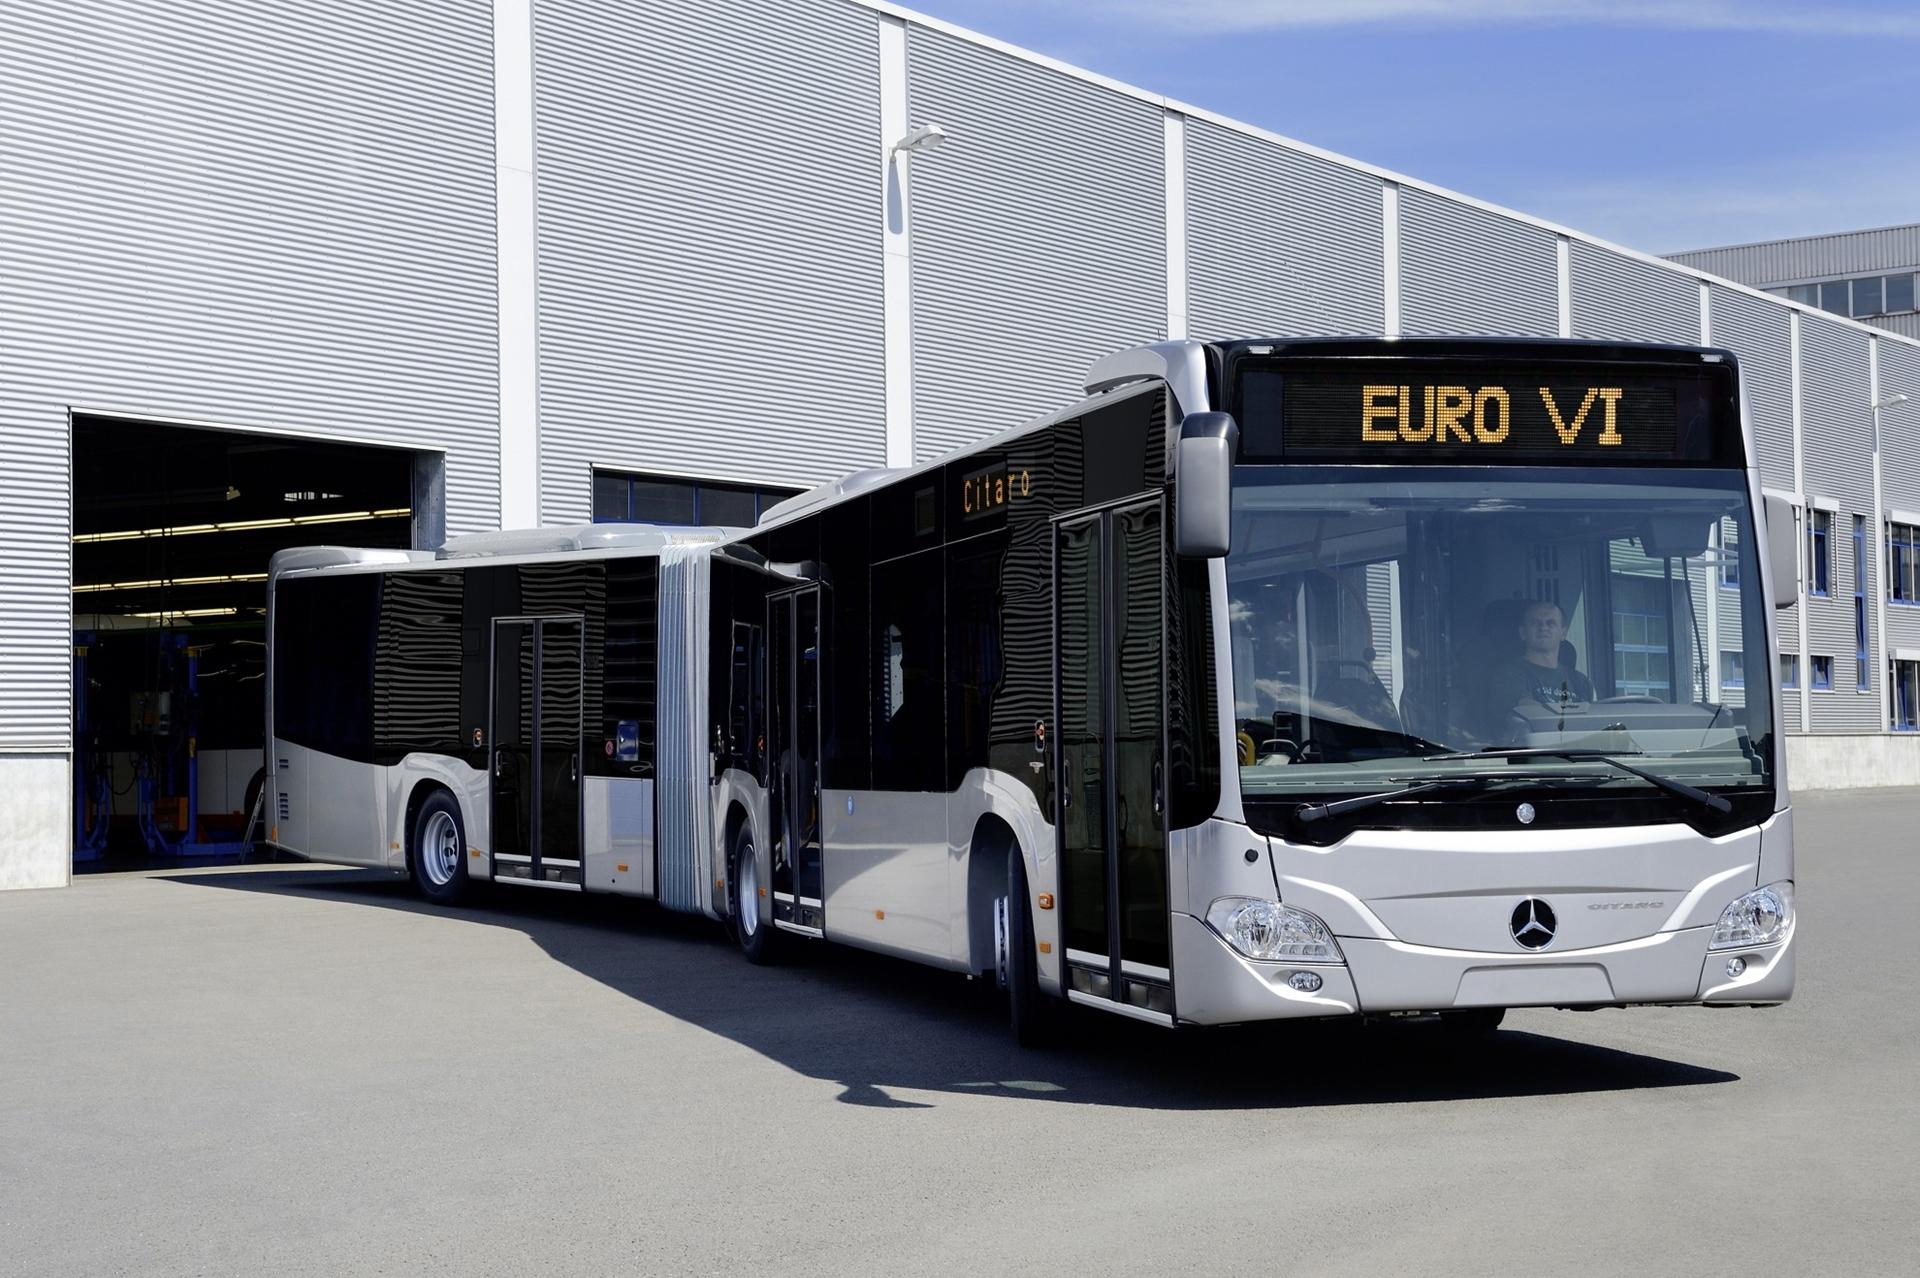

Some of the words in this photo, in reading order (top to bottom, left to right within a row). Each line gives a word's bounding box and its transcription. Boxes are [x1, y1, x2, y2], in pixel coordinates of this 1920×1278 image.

[1362, 385, 1510, 443] EURO
[1539, 387, 1623, 445] VI
[963, 469, 1029, 513] Citaro
[1587, 901, 1664, 911] CITARO
